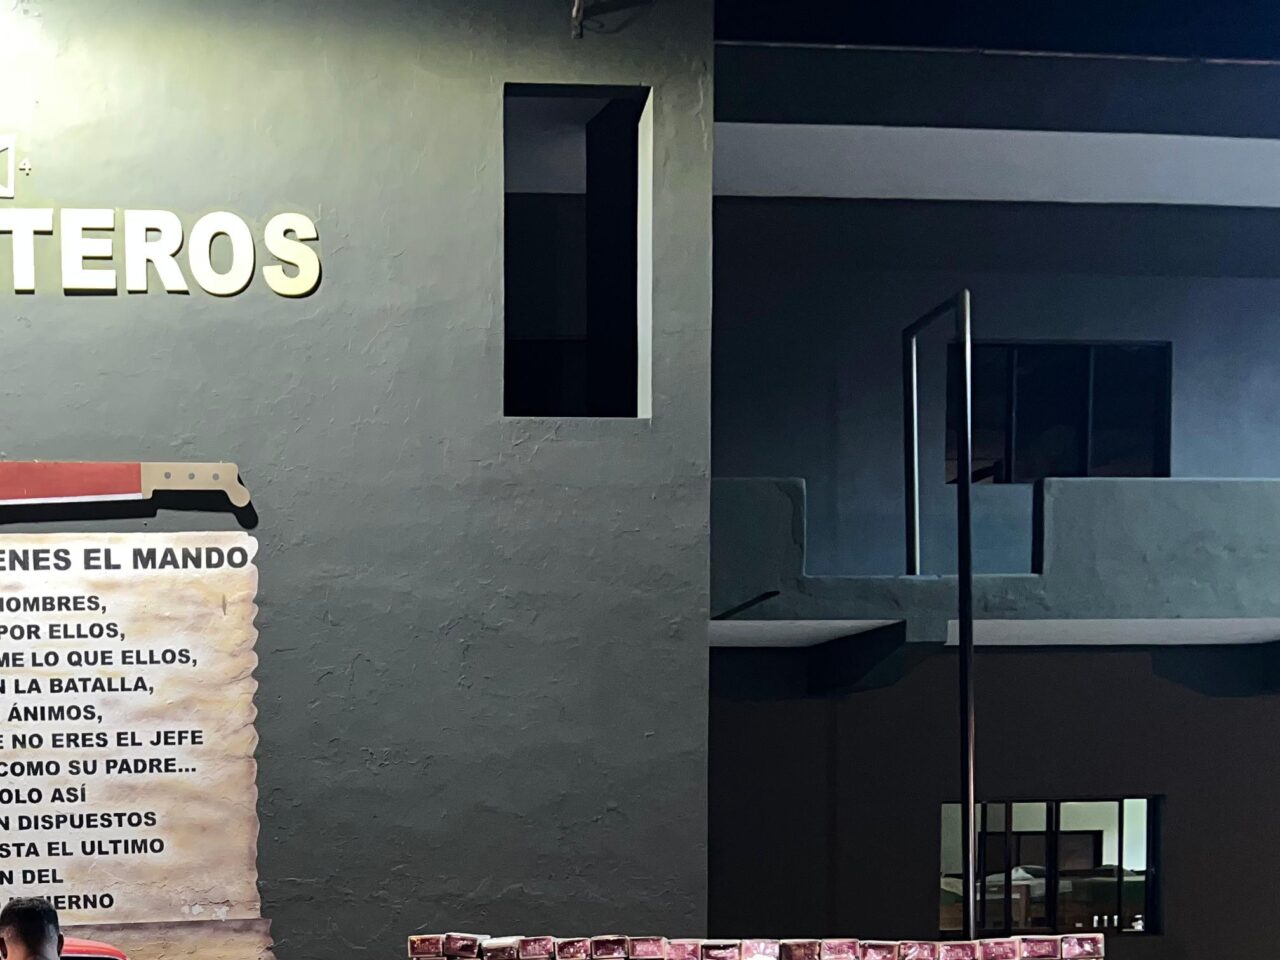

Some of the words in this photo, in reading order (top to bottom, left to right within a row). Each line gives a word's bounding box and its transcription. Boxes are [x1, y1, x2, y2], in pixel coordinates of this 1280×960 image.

[19, 157, 32, 176] 4
[84, 548, 121, 570] EL
[132, 546, 248, 570] MANDO
[49, 622, 125, 641] ELLOS,
[31, 651, 60, 667] LO
[67, 650, 113, 667] QUE
[121, 648, 197, 667] ELLOS,
[14, 678, 42, 694] LA
[49, 676, 154, 695] BATALLA,
[7, 702, 103, 724] ÁNIMOS,
[11, 733, 44, 750] NO
[51, 732, 109, 748] ERES
[116, 731, 143, 747] EL
[149, 730, 204, 746] JEFE
[68, 759, 97, 776] SU
[105, 757, 197, 775] PADRE...
[50, 784, 86, 803] ASÍ
[18, 811, 157, 831] DISPUESTOS
[47, 841, 74, 857] EL
[81, 838, 165, 856] ULTIMO
[21, 868, 64, 885] DEL
[8, 893, 115, 911] ERNO
